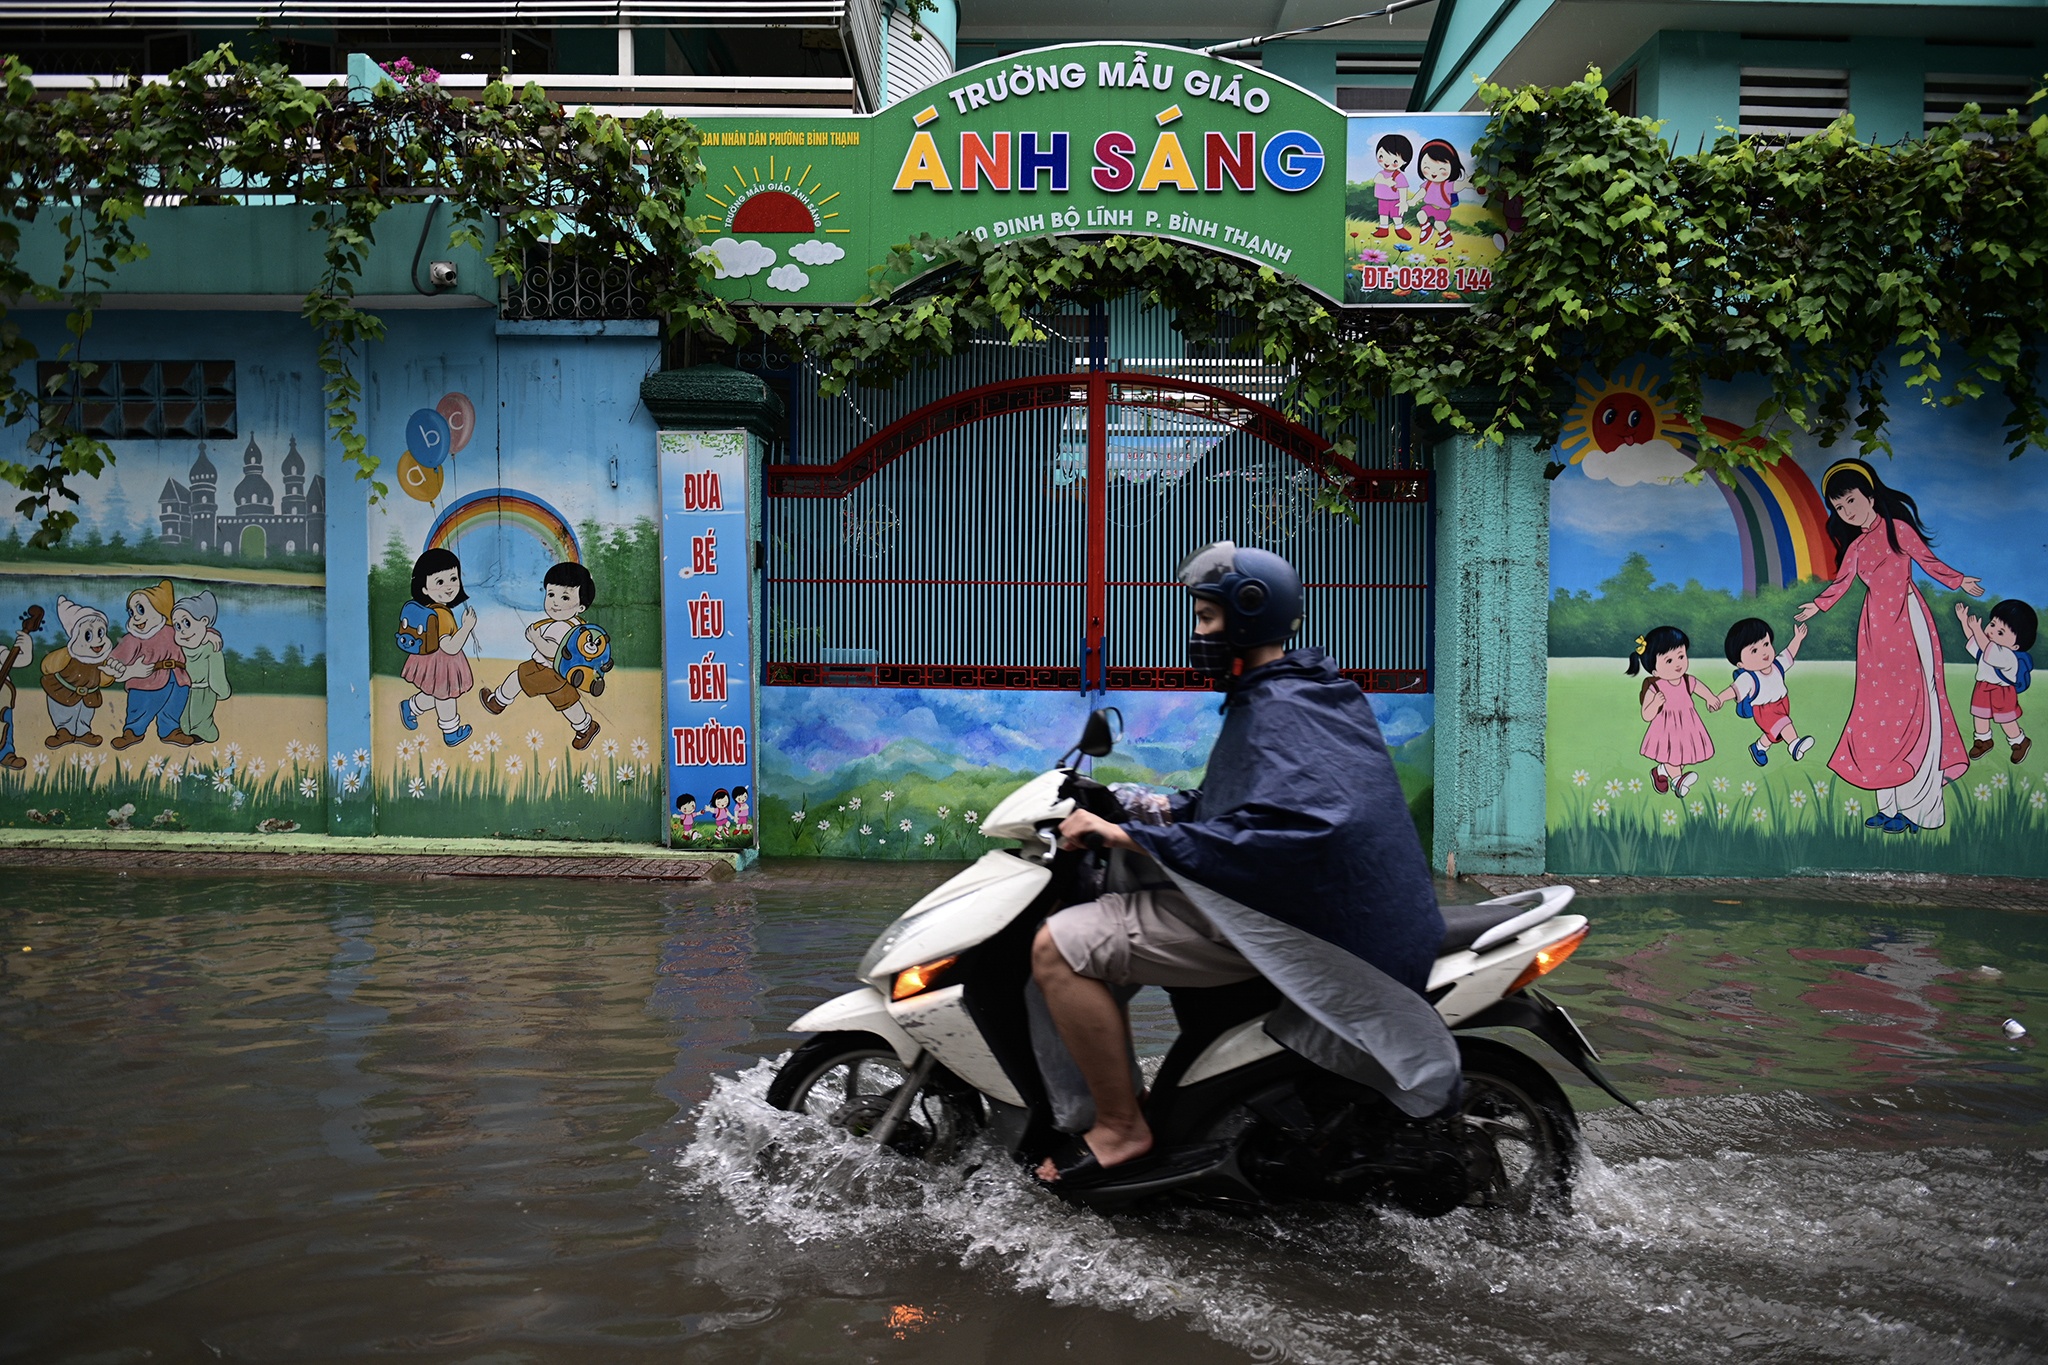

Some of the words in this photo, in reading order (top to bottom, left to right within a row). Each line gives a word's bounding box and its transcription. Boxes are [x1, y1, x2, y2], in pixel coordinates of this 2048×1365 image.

[948, 62, 1087, 115] TRƯỜNG
[1098, 50, 1175, 91] MẪU
[1184, 70, 1271, 114] GIÁO
[722, 129, 747, 146] NHÂN
[748, 129, 767, 146] DÂN
[769, 128, 805, 146] PHƯỜNG
[807, 129, 829, 146] BÌNH
[830, 131, 860, 149] THẠNH
[892, 104, 1070, 192] ÁNH
[1091, 104, 1325, 192] SÁNG
[724, 195, 746, 228] TRƯỜNG
[745, 183, 766, 198] MẪU
[767, 182, 791, 193] GIÁO
[791, 188, 810, 205] ÁNH
[807, 203, 822, 228] SÁNG
[993, 213, 1045, 239] ĐINH
[1050, 205, 1081, 232] BỘ
[1087, 205, 1133, 227] LĨNH
[1145, 210, 1162, 229] P.
[1168, 210, 1219, 239] BÌNH
[1224, 225, 1293, 265] THẠNH
[1362, 265, 1394, 290] ĐT:
[1397, 265, 1451, 290] 0328
[1455, 267, 1492, 291] 144
[683, 470, 723, 512] ĐƯA
[691, 527, 718, 576] BÉ
[687, 592, 724, 639] YÊU
[688, 651, 727, 702] ĐẾN
[672, 717, 746, 767] TRƯỜNG
